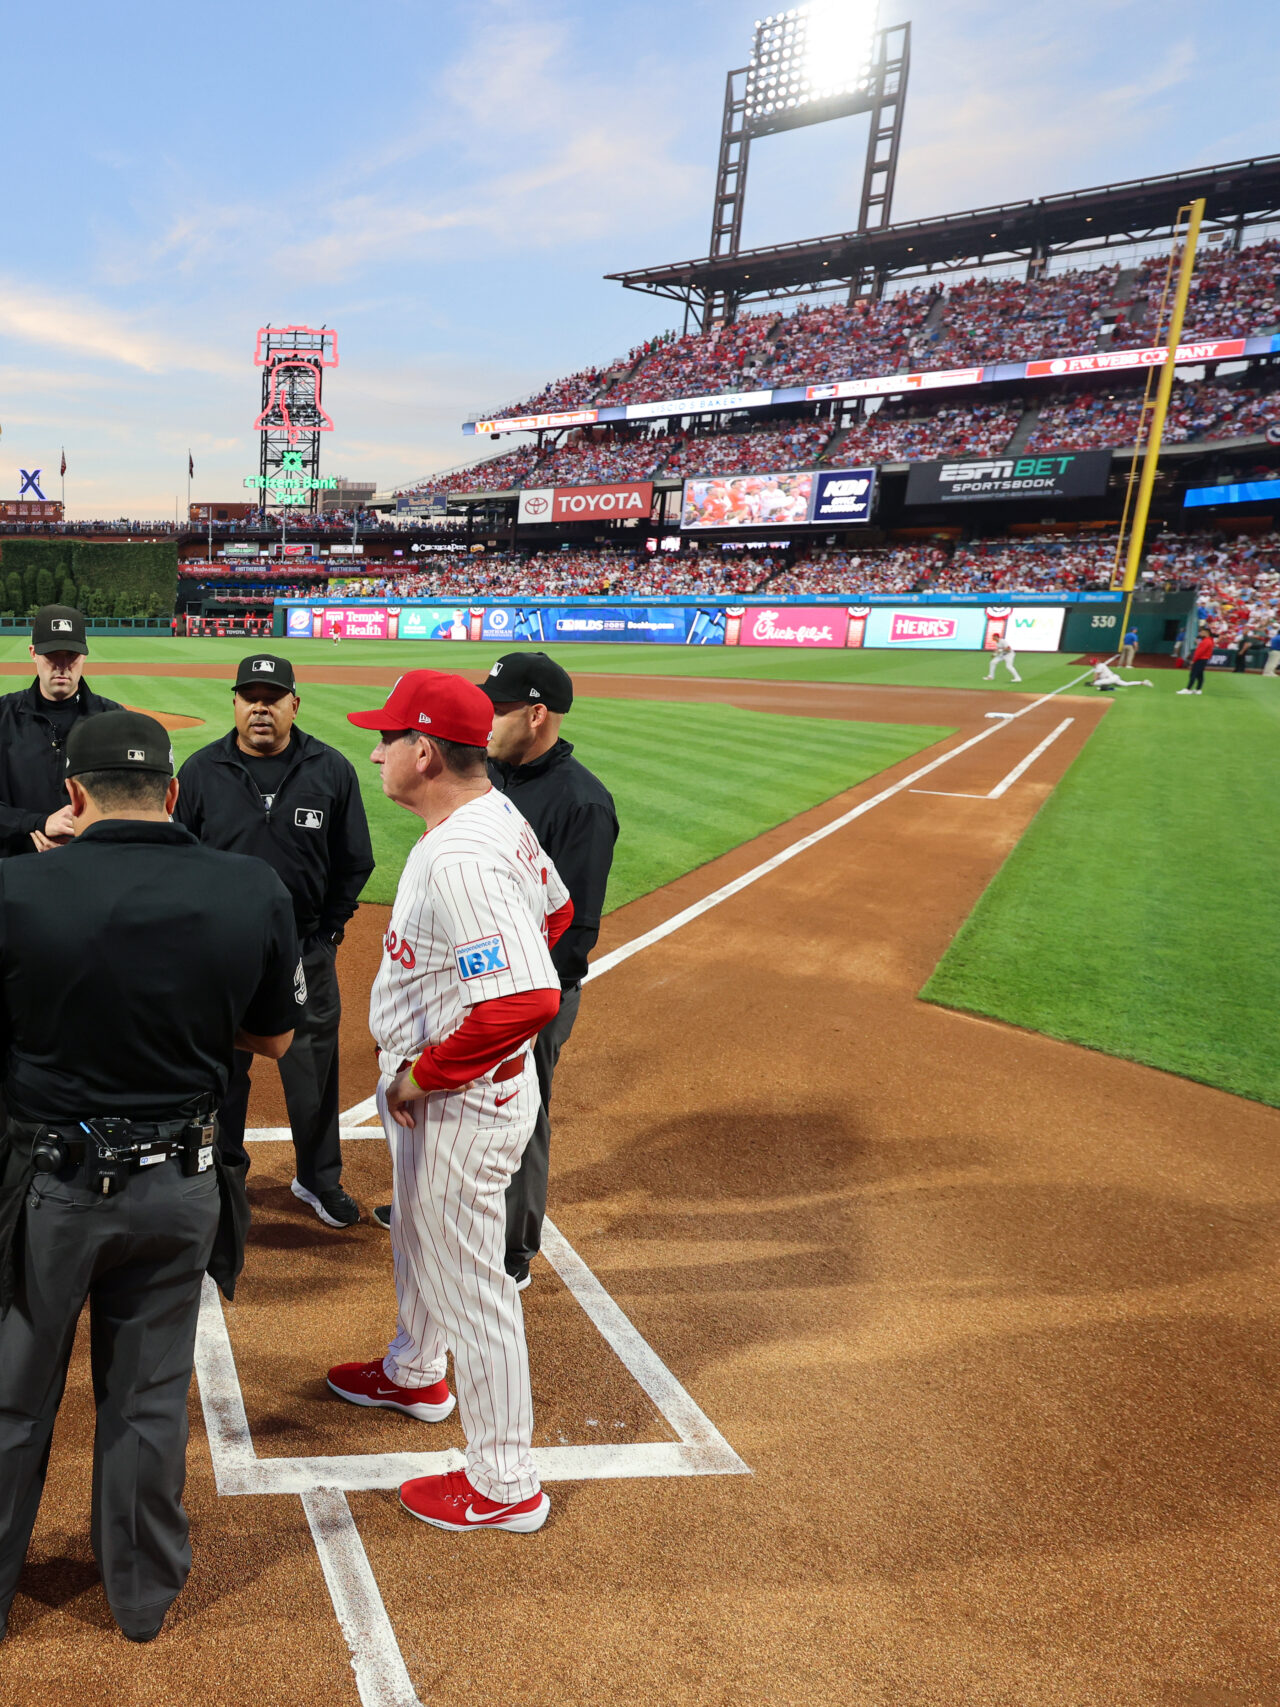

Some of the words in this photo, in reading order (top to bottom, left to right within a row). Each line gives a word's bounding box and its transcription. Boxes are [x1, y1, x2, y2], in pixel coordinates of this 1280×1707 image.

[1096, 353, 1139, 367] WEBB
[939, 460, 1014, 481] ESPN
[1014, 456, 1075, 477] BET
[245, 475, 300, 489] Citizens
[303, 475, 337, 489] Bank
[951, 478, 1056, 492] SPORTSBOOK
[275, 491, 305, 505] Park
[558, 492, 643, 513] TOYOTA
[346, 611, 385, 623] Temple
[1091, 615, 1117, 627] 330
[346, 624, 381, 636] Health
[896, 619, 950, 636] HERR'S
[457, 941, 492, 954] Independence
[458, 945, 505, 978] IBX
